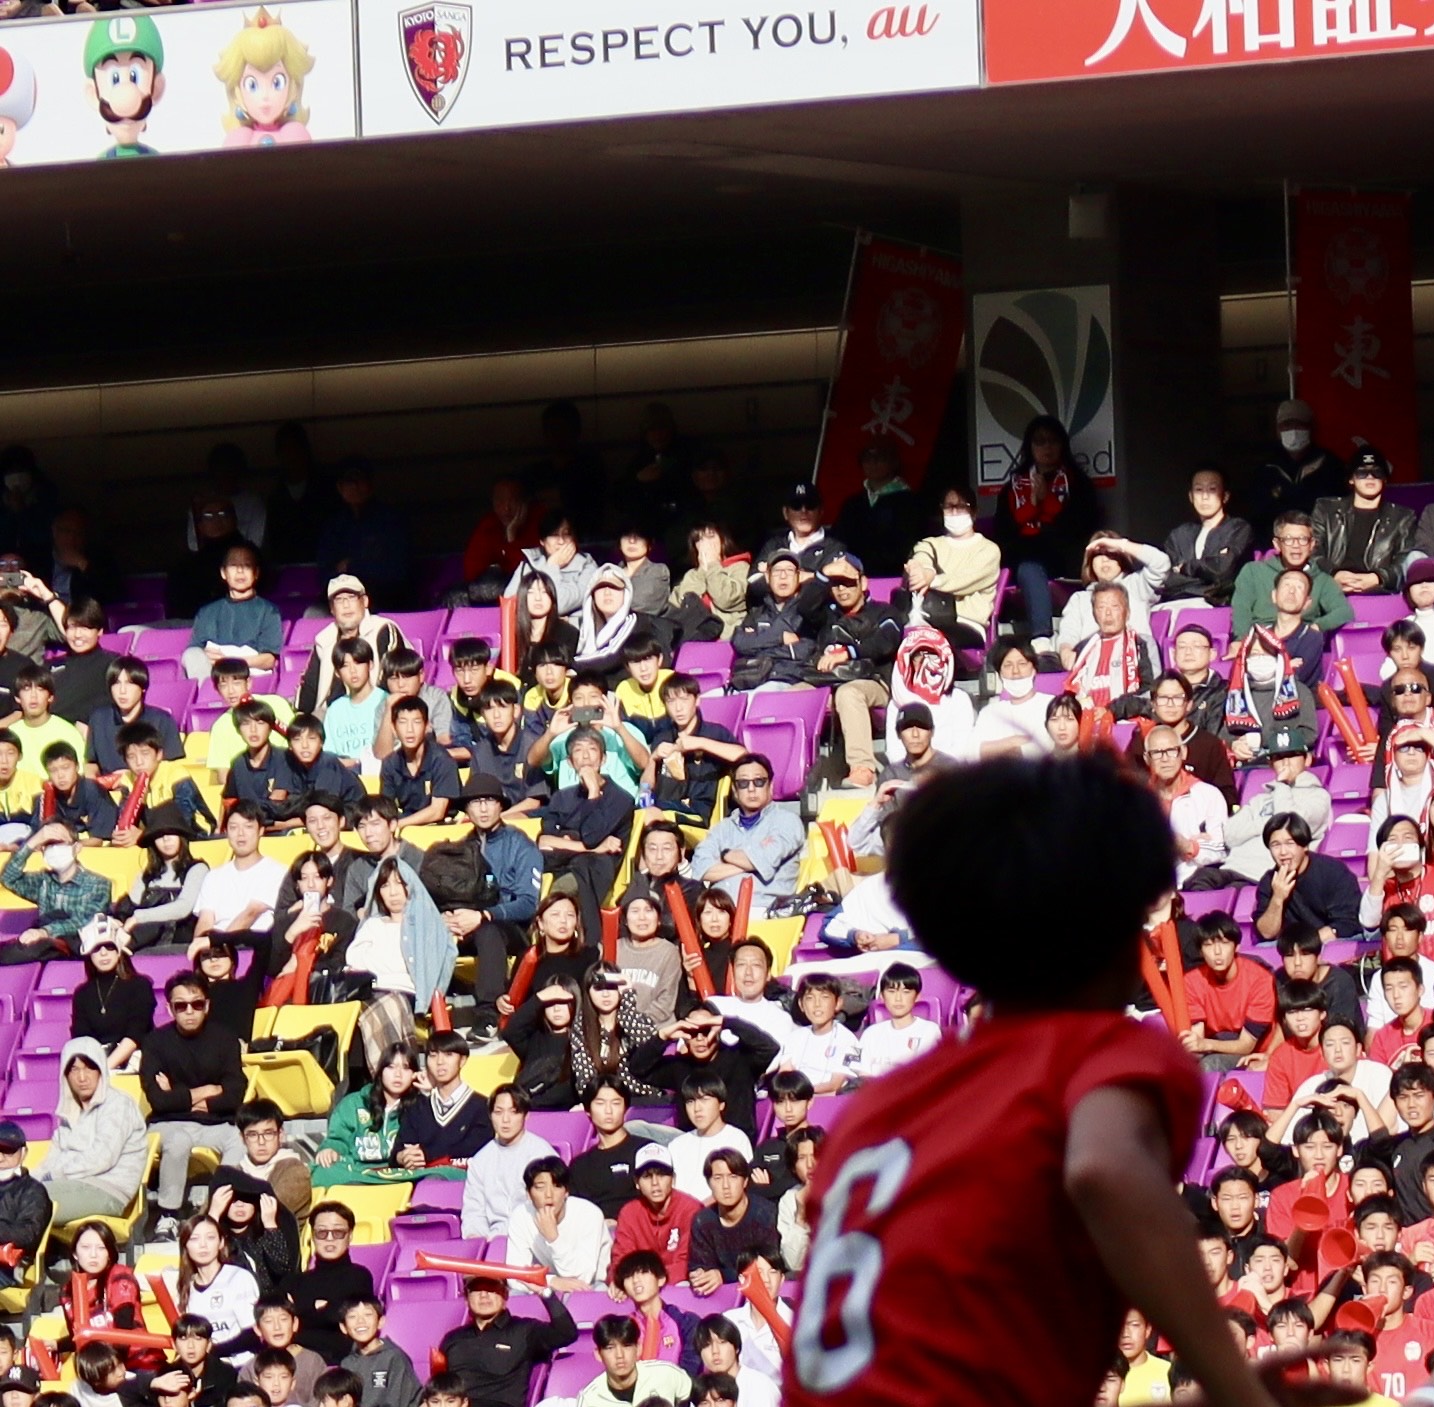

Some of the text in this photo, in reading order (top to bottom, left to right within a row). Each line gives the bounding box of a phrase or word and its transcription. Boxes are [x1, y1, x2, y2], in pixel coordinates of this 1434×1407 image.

[404, 11, 467, 27] KYOTO SANGA
[504, 2, 940, 71] RESPECT YOU, au
[981, 440, 1112, 484] EXed
[793, 1137, 914, 1391] 6
[1381, 1372, 1406, 1398] 70
